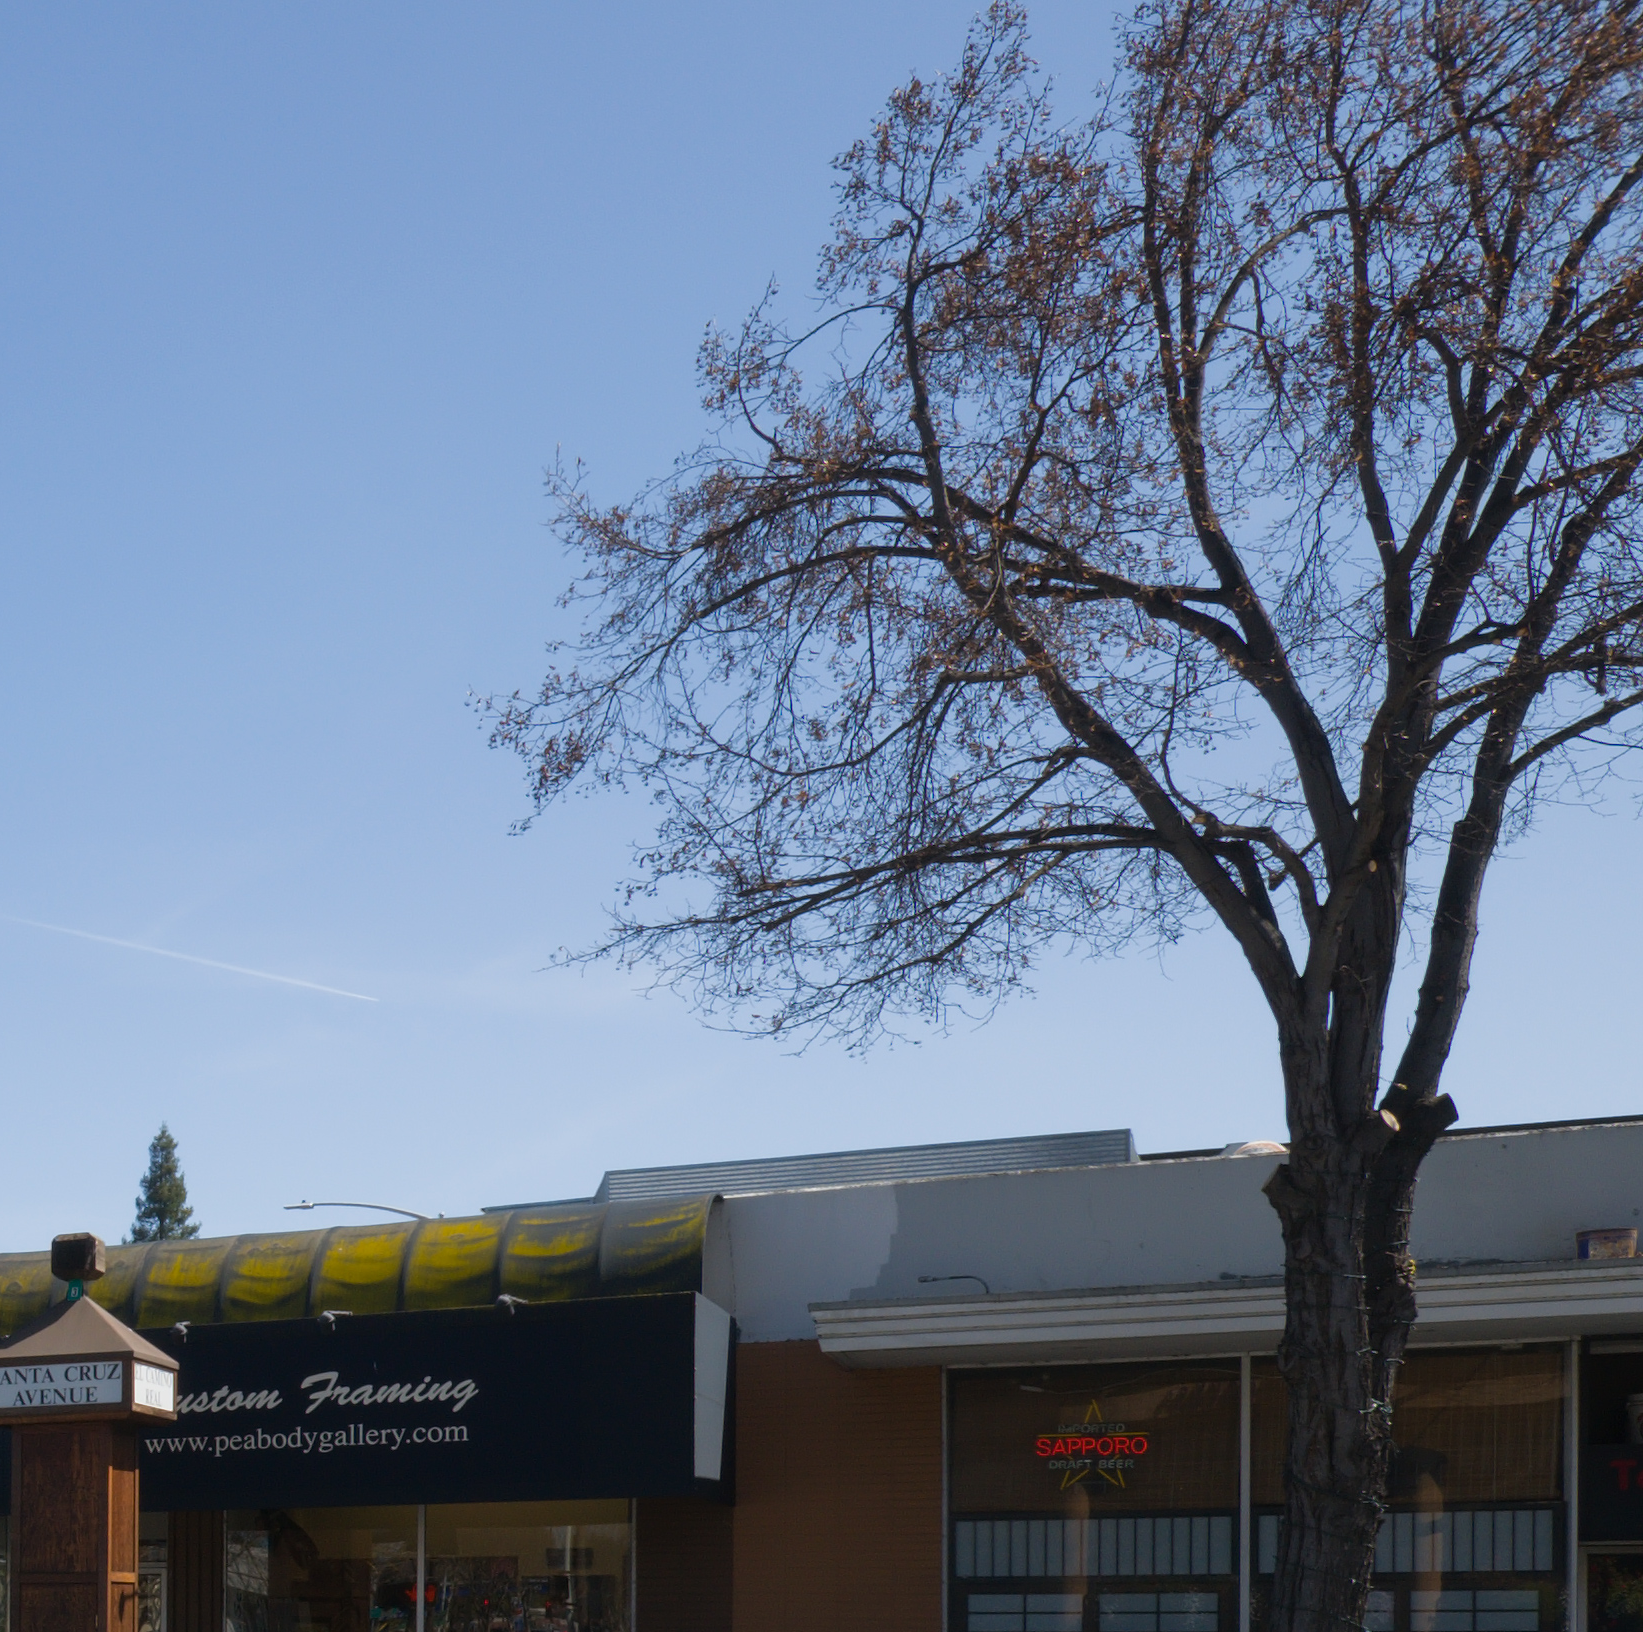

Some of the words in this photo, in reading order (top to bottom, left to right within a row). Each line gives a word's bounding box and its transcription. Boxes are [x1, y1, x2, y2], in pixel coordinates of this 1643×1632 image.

[64, 1363, 121, 1382] CRUZ
[12, 1386, 98, 1406] AVENUE
[145, 1388, 162, 1407] REAL
[176, 1385, 283, 1414] ustom
[301, 1371, 479, 1413] Framing
[1058, 1423, 1126, 1433] IMPORTED
[145, 1424, 469, 1457] www.peabodygallery.com
[1036, 1437, 1148, 1457] SAPPORO
[1049, 1459, 1093, 1469] DRAFT
[1098, 1459, 1134, 1469] BEER
